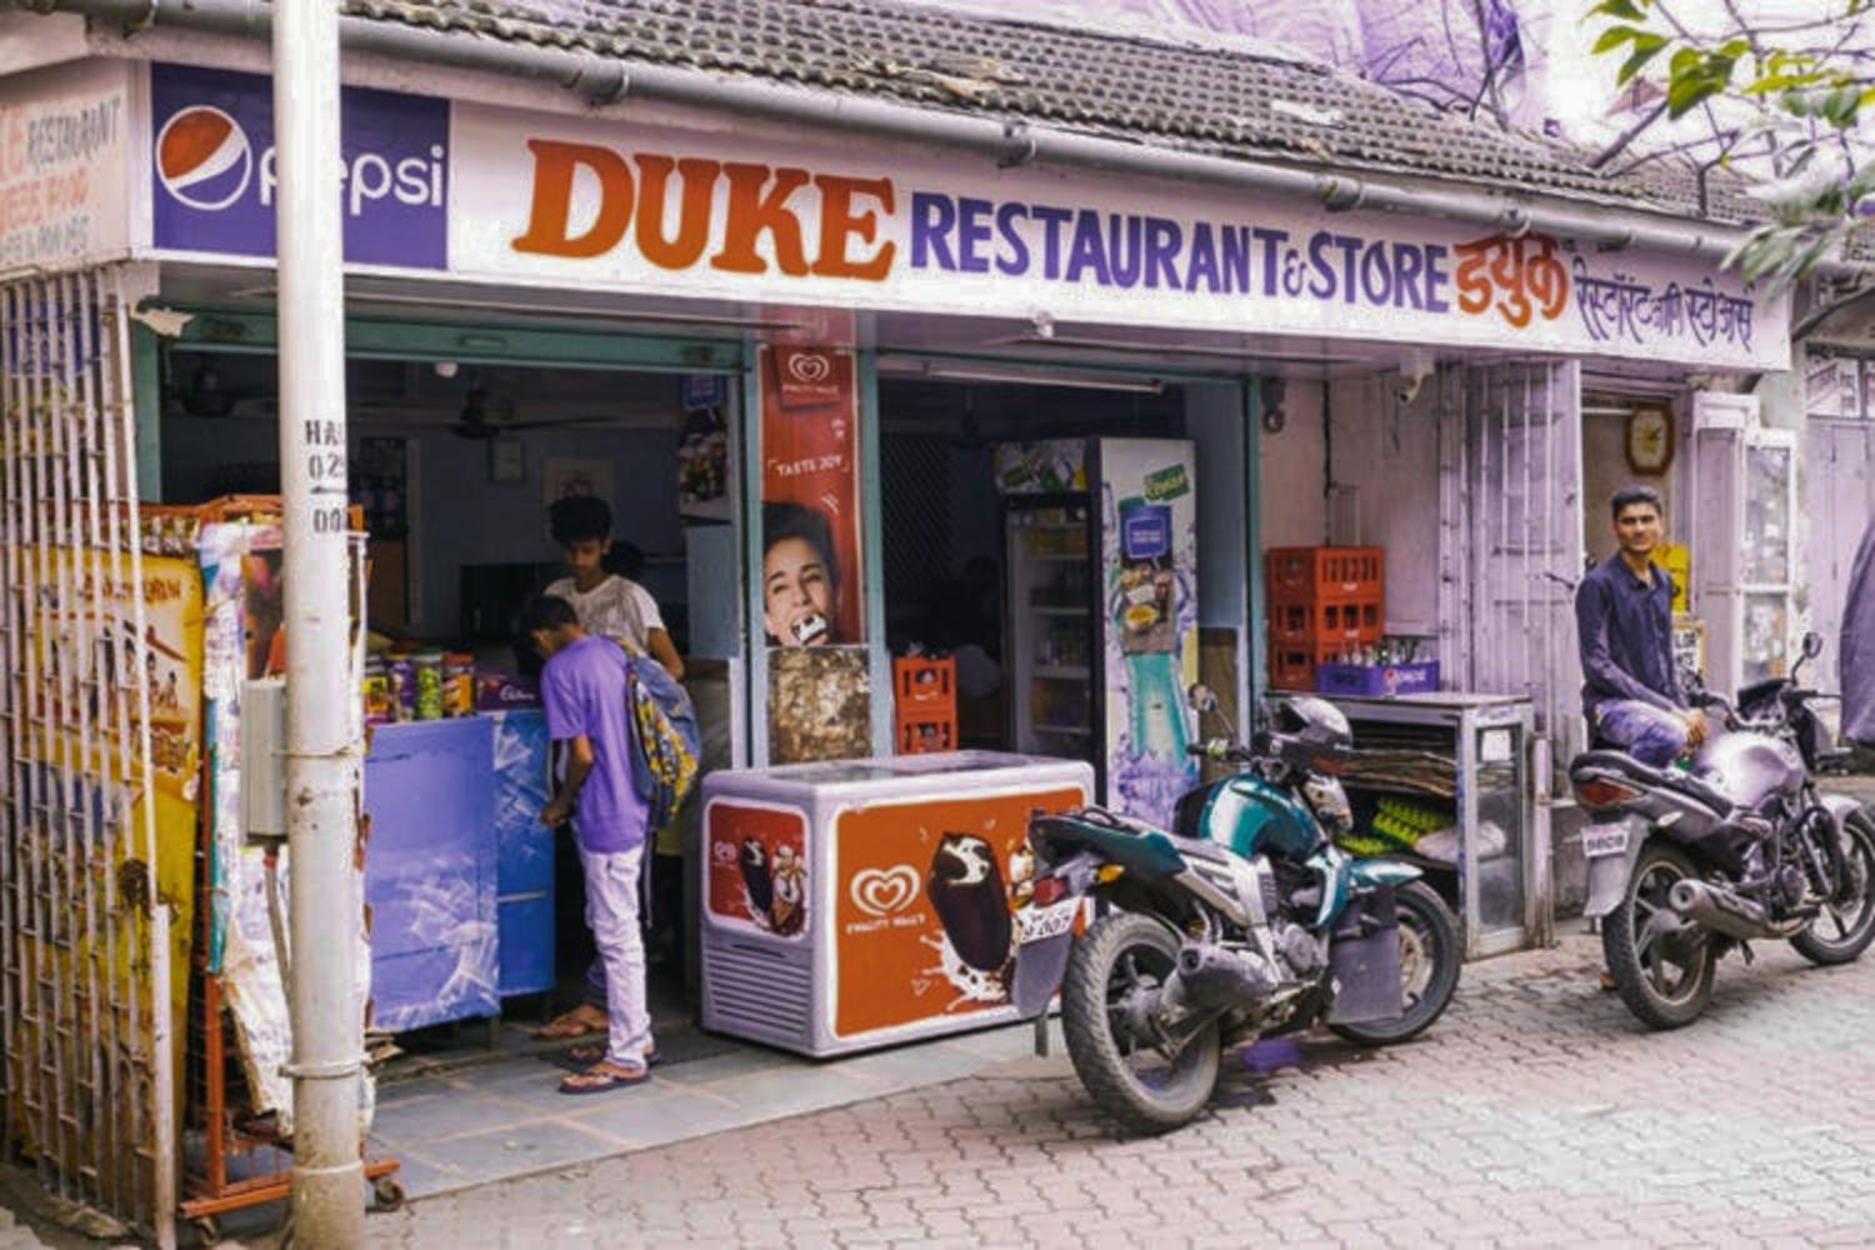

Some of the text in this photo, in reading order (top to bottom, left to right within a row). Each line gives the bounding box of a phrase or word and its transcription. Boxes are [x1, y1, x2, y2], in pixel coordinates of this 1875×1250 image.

[260, 144, 445, 216] ppsi
[511, 138, 897, 282] DUKE
[910, 191, 1288, 297] RESTAURANT
[1309, 230, 1450, 314] STORE
[305, 420, 343, 445] HA
[309, 453, 343, 478] 02
